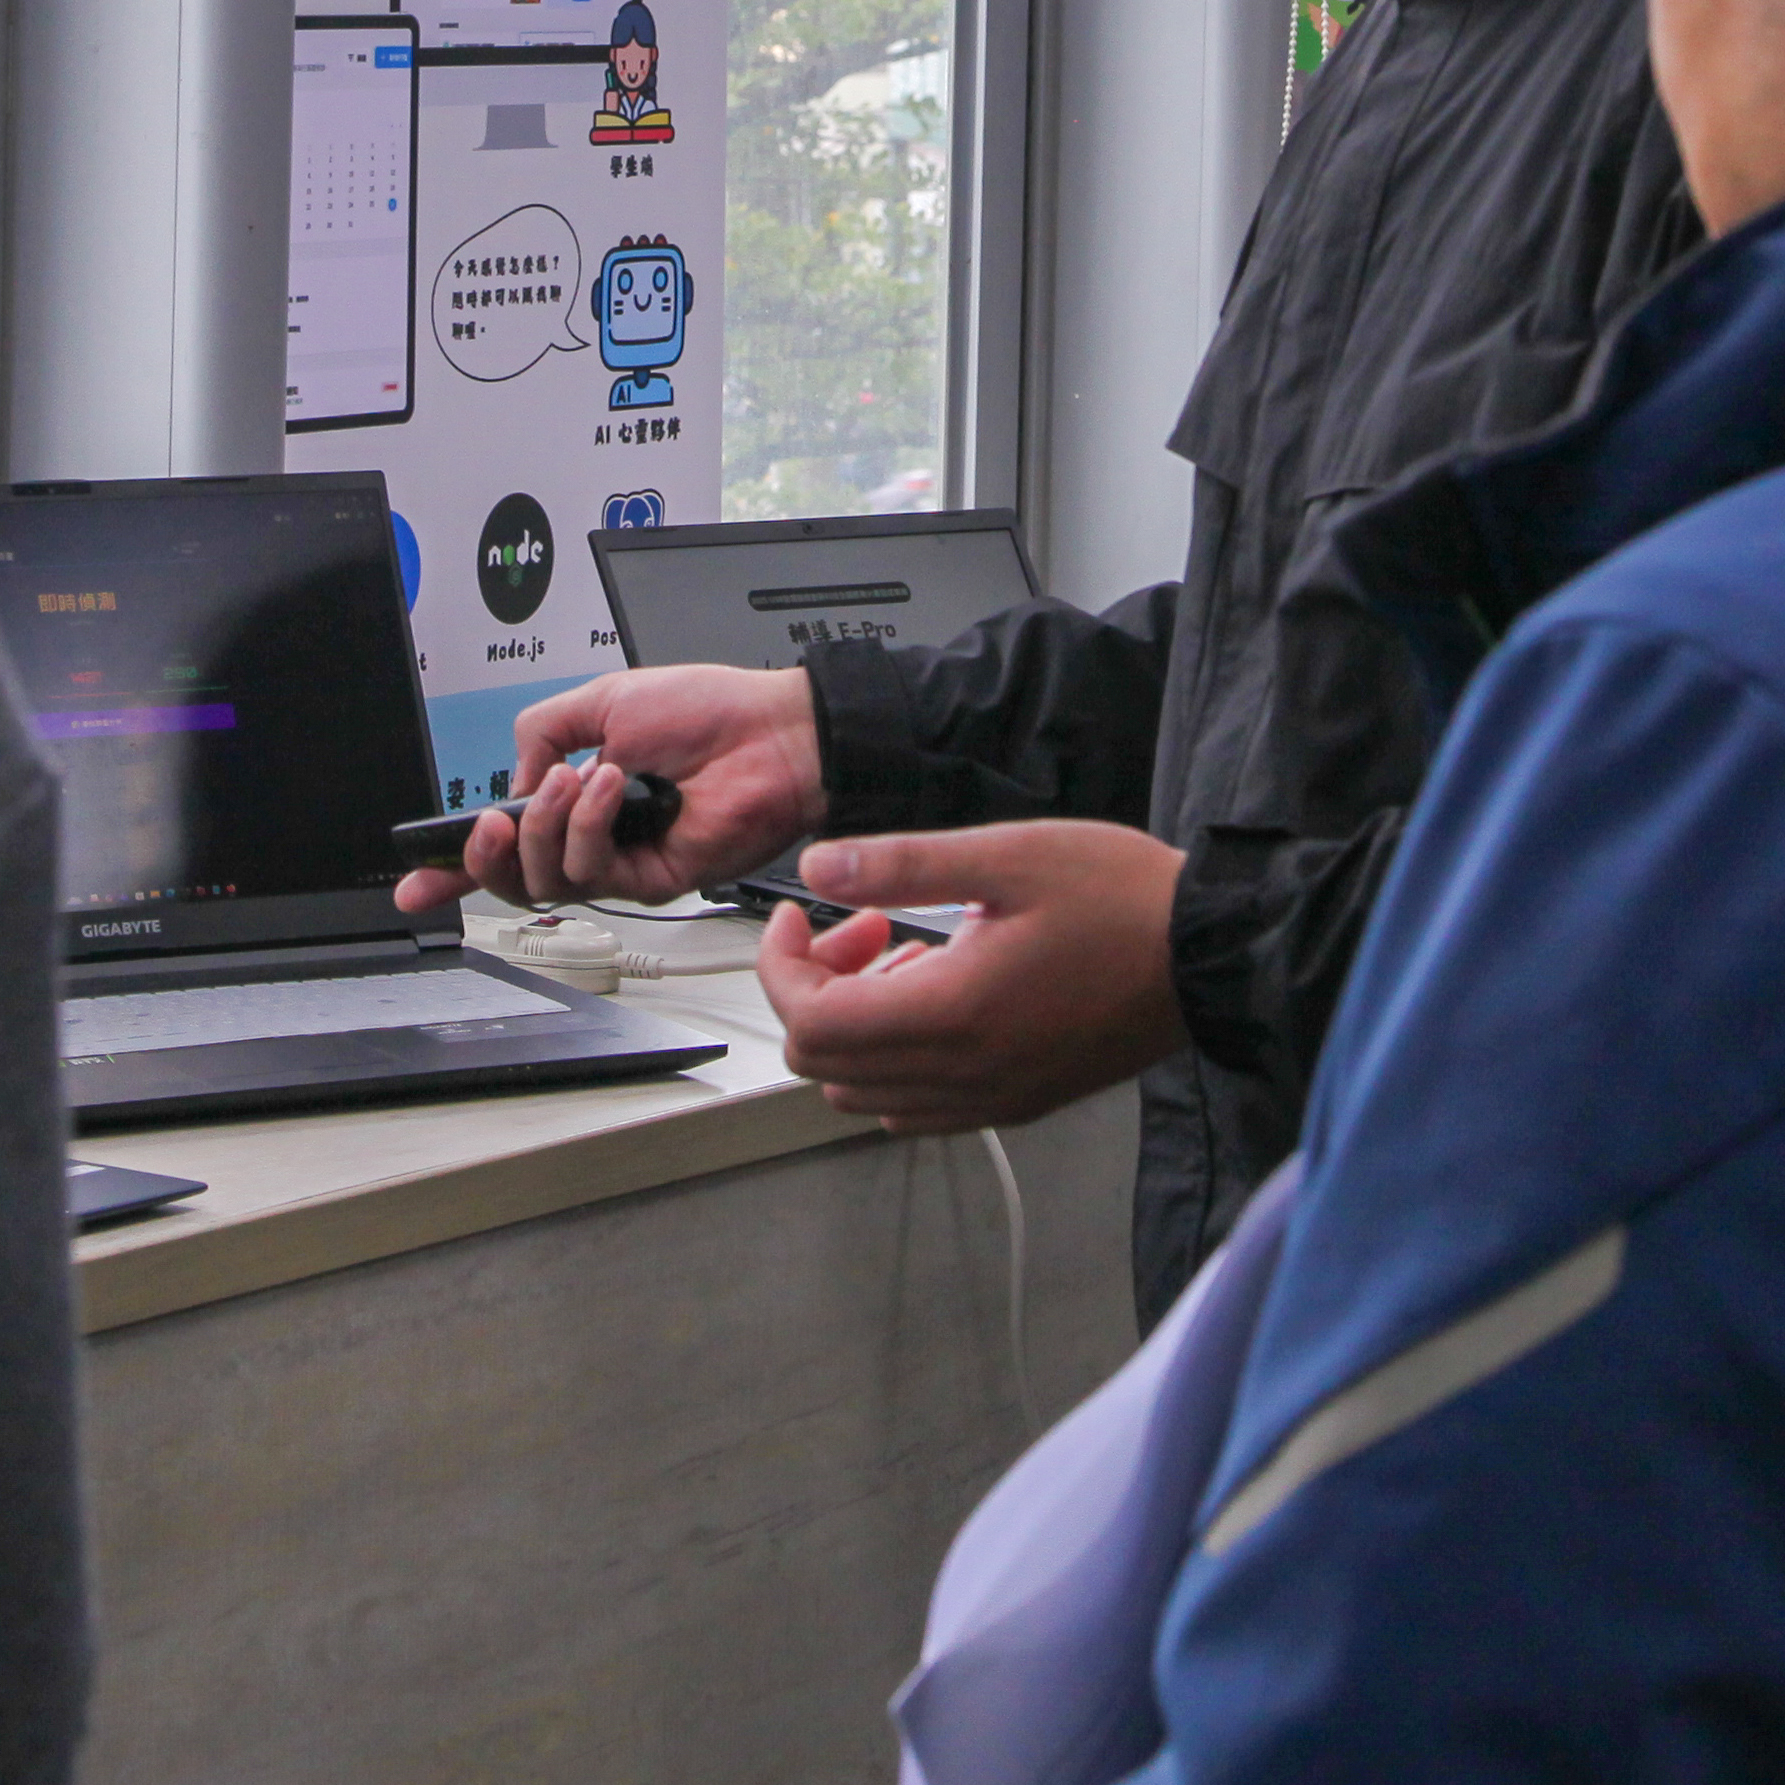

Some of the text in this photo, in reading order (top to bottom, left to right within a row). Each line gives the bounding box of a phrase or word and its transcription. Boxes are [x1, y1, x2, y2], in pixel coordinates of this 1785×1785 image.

[617, 384, 631, 404] AI
[594, 424, 610, 446] AI
[488, 529, 544, 567] node
[590, 629, 617, 648] Pos
[838, 620, 897, 641] E-Pro
[487, 636, 545, 662] Node.js
[81, 920, 162, 938] GIGABYTE
